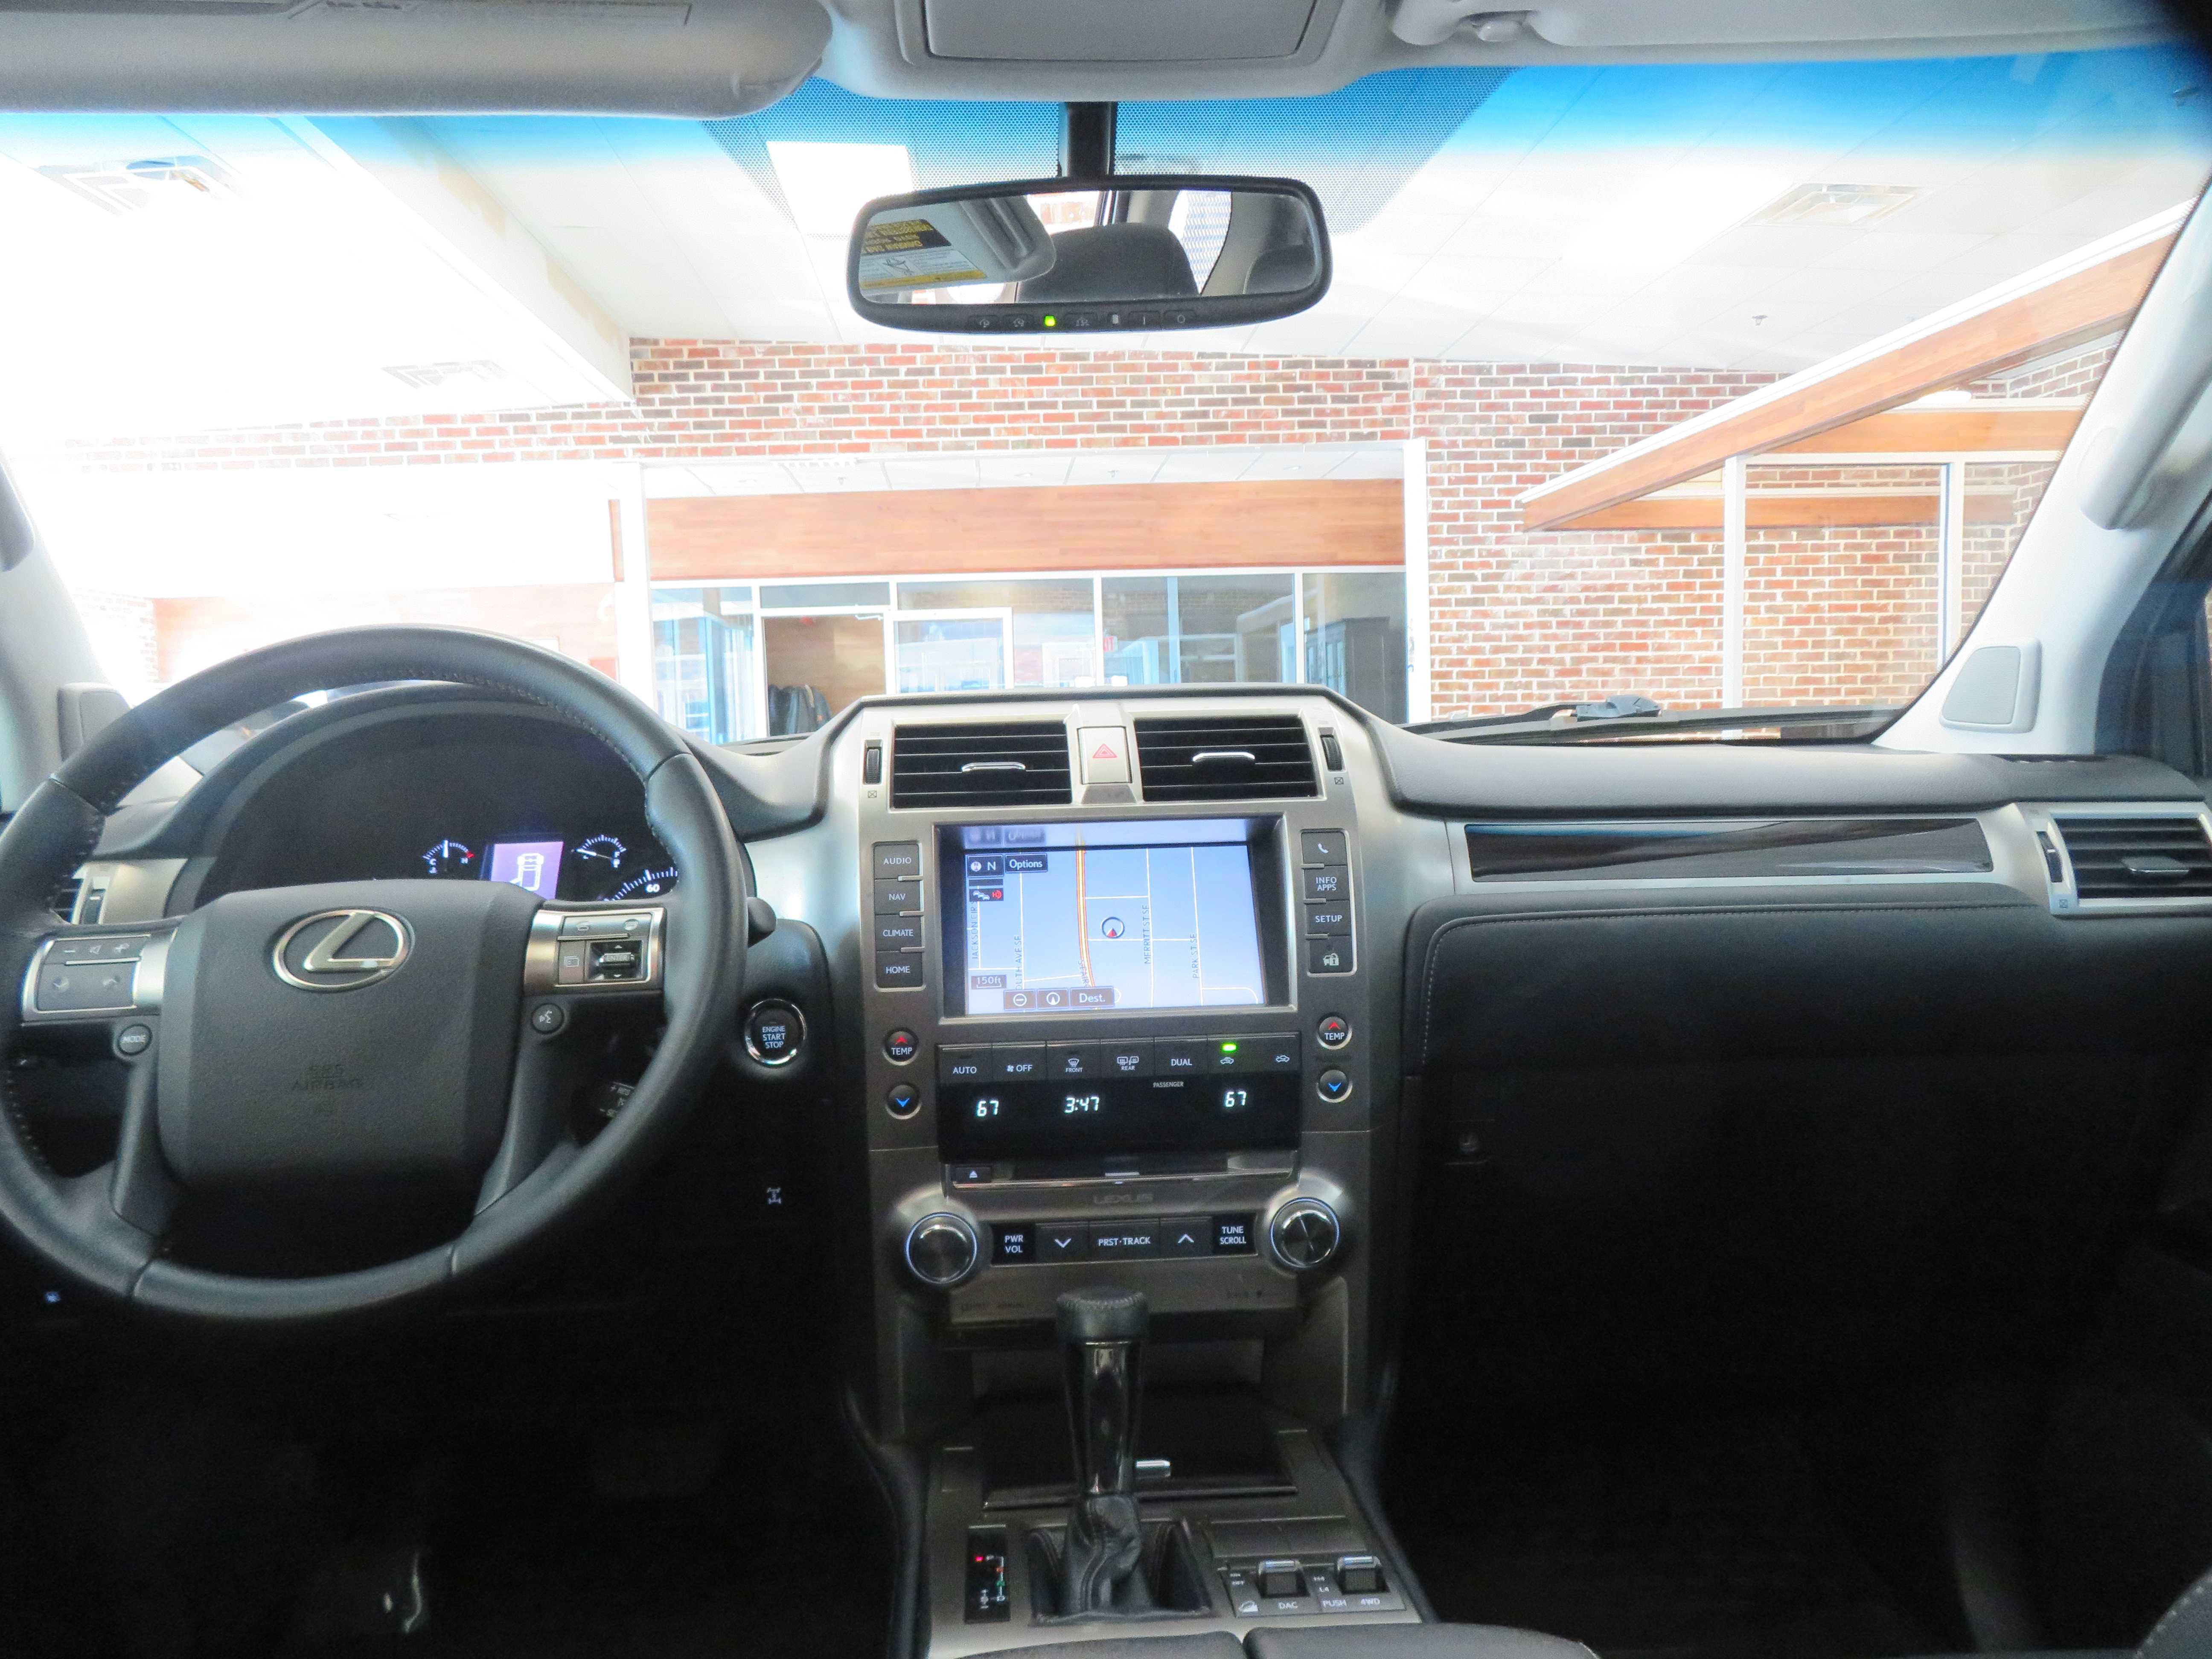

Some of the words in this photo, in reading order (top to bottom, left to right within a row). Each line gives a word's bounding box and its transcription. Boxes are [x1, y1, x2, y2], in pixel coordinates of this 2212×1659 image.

[883, 856, 912, 865] AUDIO
[1009, 859, 1043, 870] Options
[987, 861, 996, 871] N
[1316, 876, 1337, 884] INFO
[646, 883, 661, 893] 60
[1142, 905, 1149, 914] SE
[1143, 916, 1150, 926] ST
[1315, 914, 1343, 923] SETUP
[882, 929, 914, 937] CLIMATE
[1014, 935, 1022, 946] SE
[1190, 934, 1197, 943] SE
[1190, 945, 1198, 955] ST
[885, 966, 911, 974] HOME
[976, 976, 1001, 984] 150ft
[1079, 993, 1106, 1003] Dest.
[1324, 1032, 1345, 1040] TEMP
[891, 1047, 913, 1055] TEMP
[1171, 1058, 1192, 1066] DUAL
[952, 1066, 977, 1074] AUTO
[1224, 1091, 1247, 1108] 67
[975, 1100, 999, 1117] 67
[1064, 1095, 1100, 1114] 3:47
[1221, 1225, 1244, 1234] TUNE
[1004, 1234, 1024, 1243] PWR
[1220, 1236, 1247, 1245] SCROLL
[1005, 1245, 1024, 1253] VOL
[1278, 1601, 1298, 1610] DAC
[1321, 1599, 1347, 1607] PUSH
